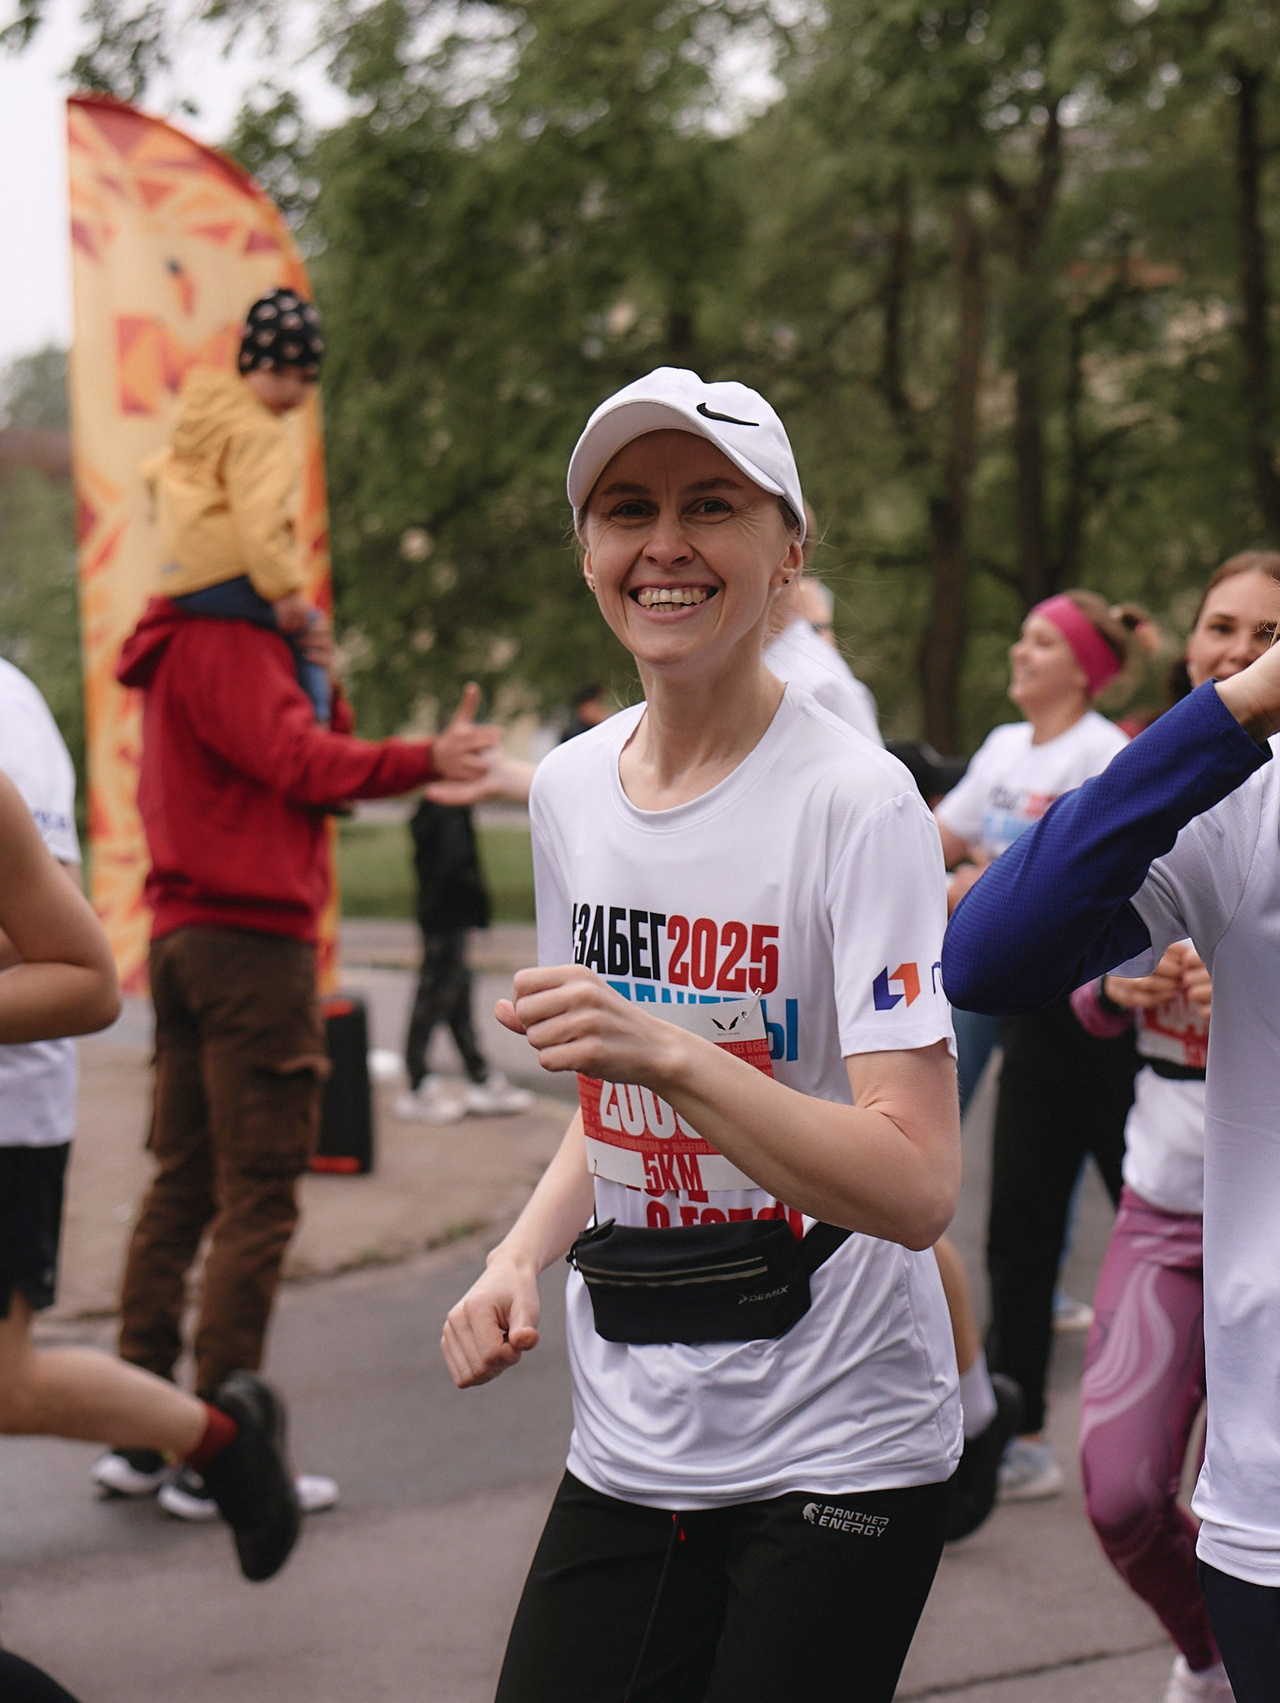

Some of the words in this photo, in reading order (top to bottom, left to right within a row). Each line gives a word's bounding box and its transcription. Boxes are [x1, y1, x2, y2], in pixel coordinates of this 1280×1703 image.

[599, 1080, 702, 1139] 200
[643, 1152, 704, 1190] 5КМ
[749, 1285, 789, 1302] DEMIX
[818, 1515, 885, 1537] ENERGY
[823, 1505, 889, 1526] PANTHER
